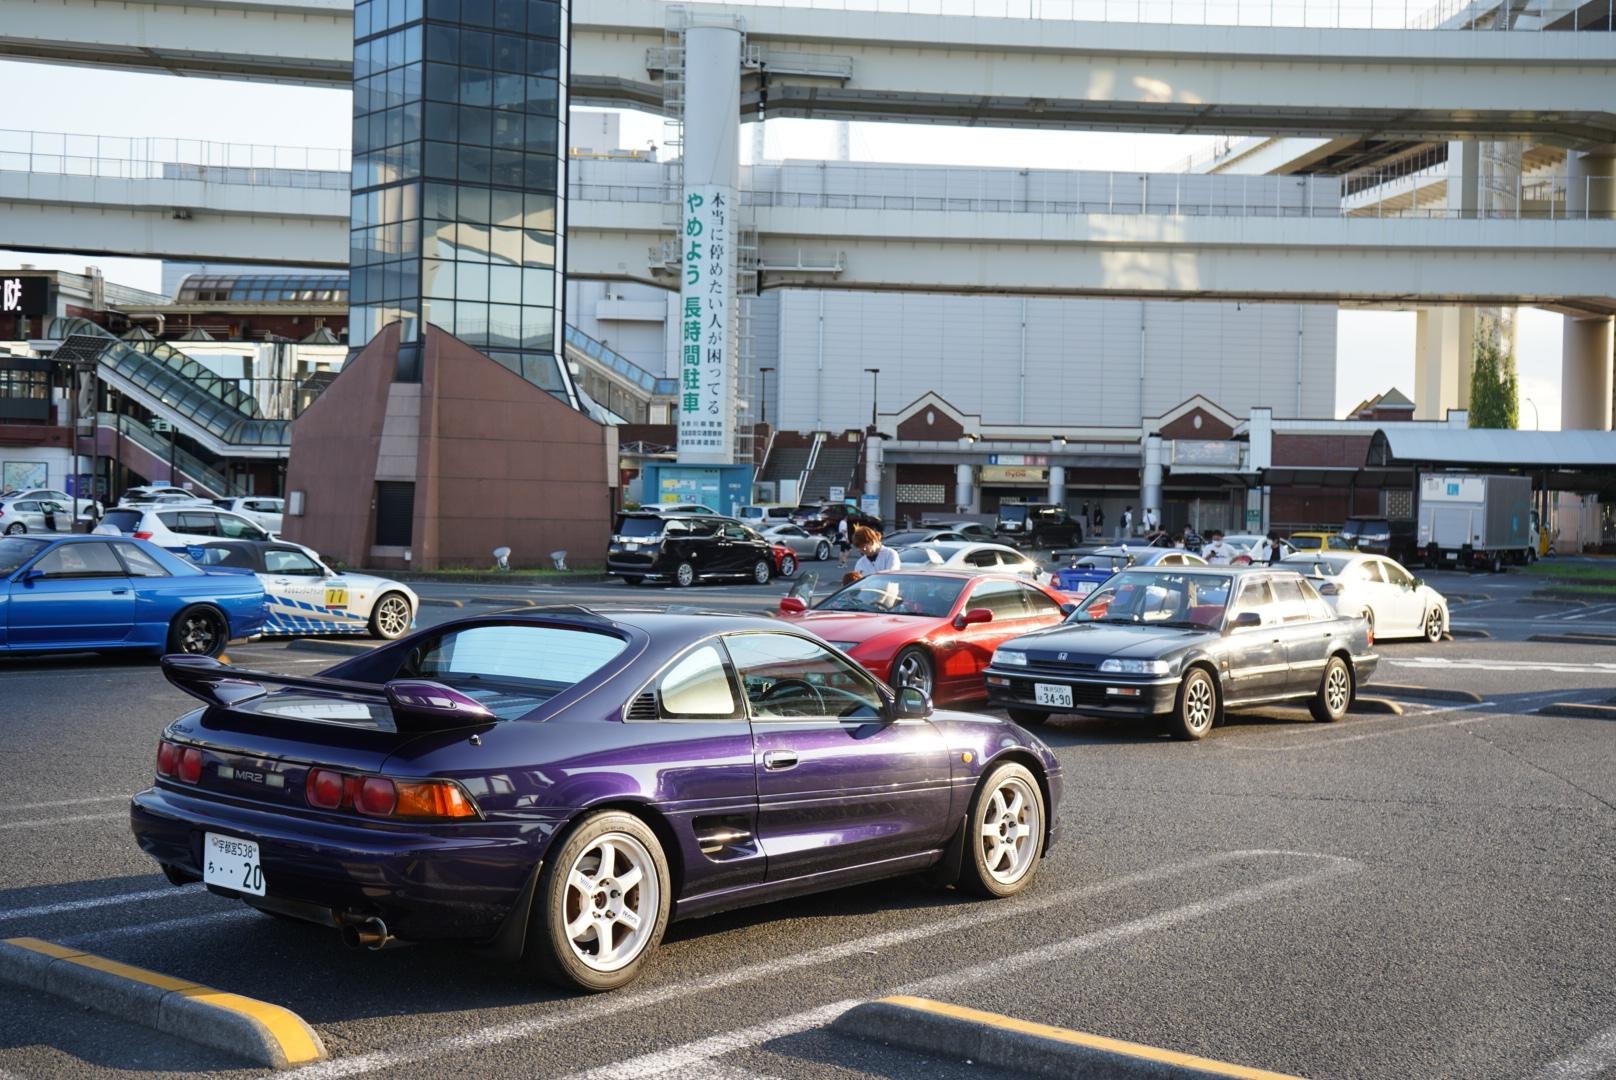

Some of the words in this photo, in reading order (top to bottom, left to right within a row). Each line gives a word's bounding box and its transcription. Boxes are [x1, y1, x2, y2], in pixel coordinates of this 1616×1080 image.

[686, 193, 704, 285] やめよう
[707, 192, 725, 415] 本当に停めたい人が困ってる
[682, 296, 701, 414] 長時間駐車
[329, 588, 345, 604] 77
[235, 769, 264, 784] MR2
